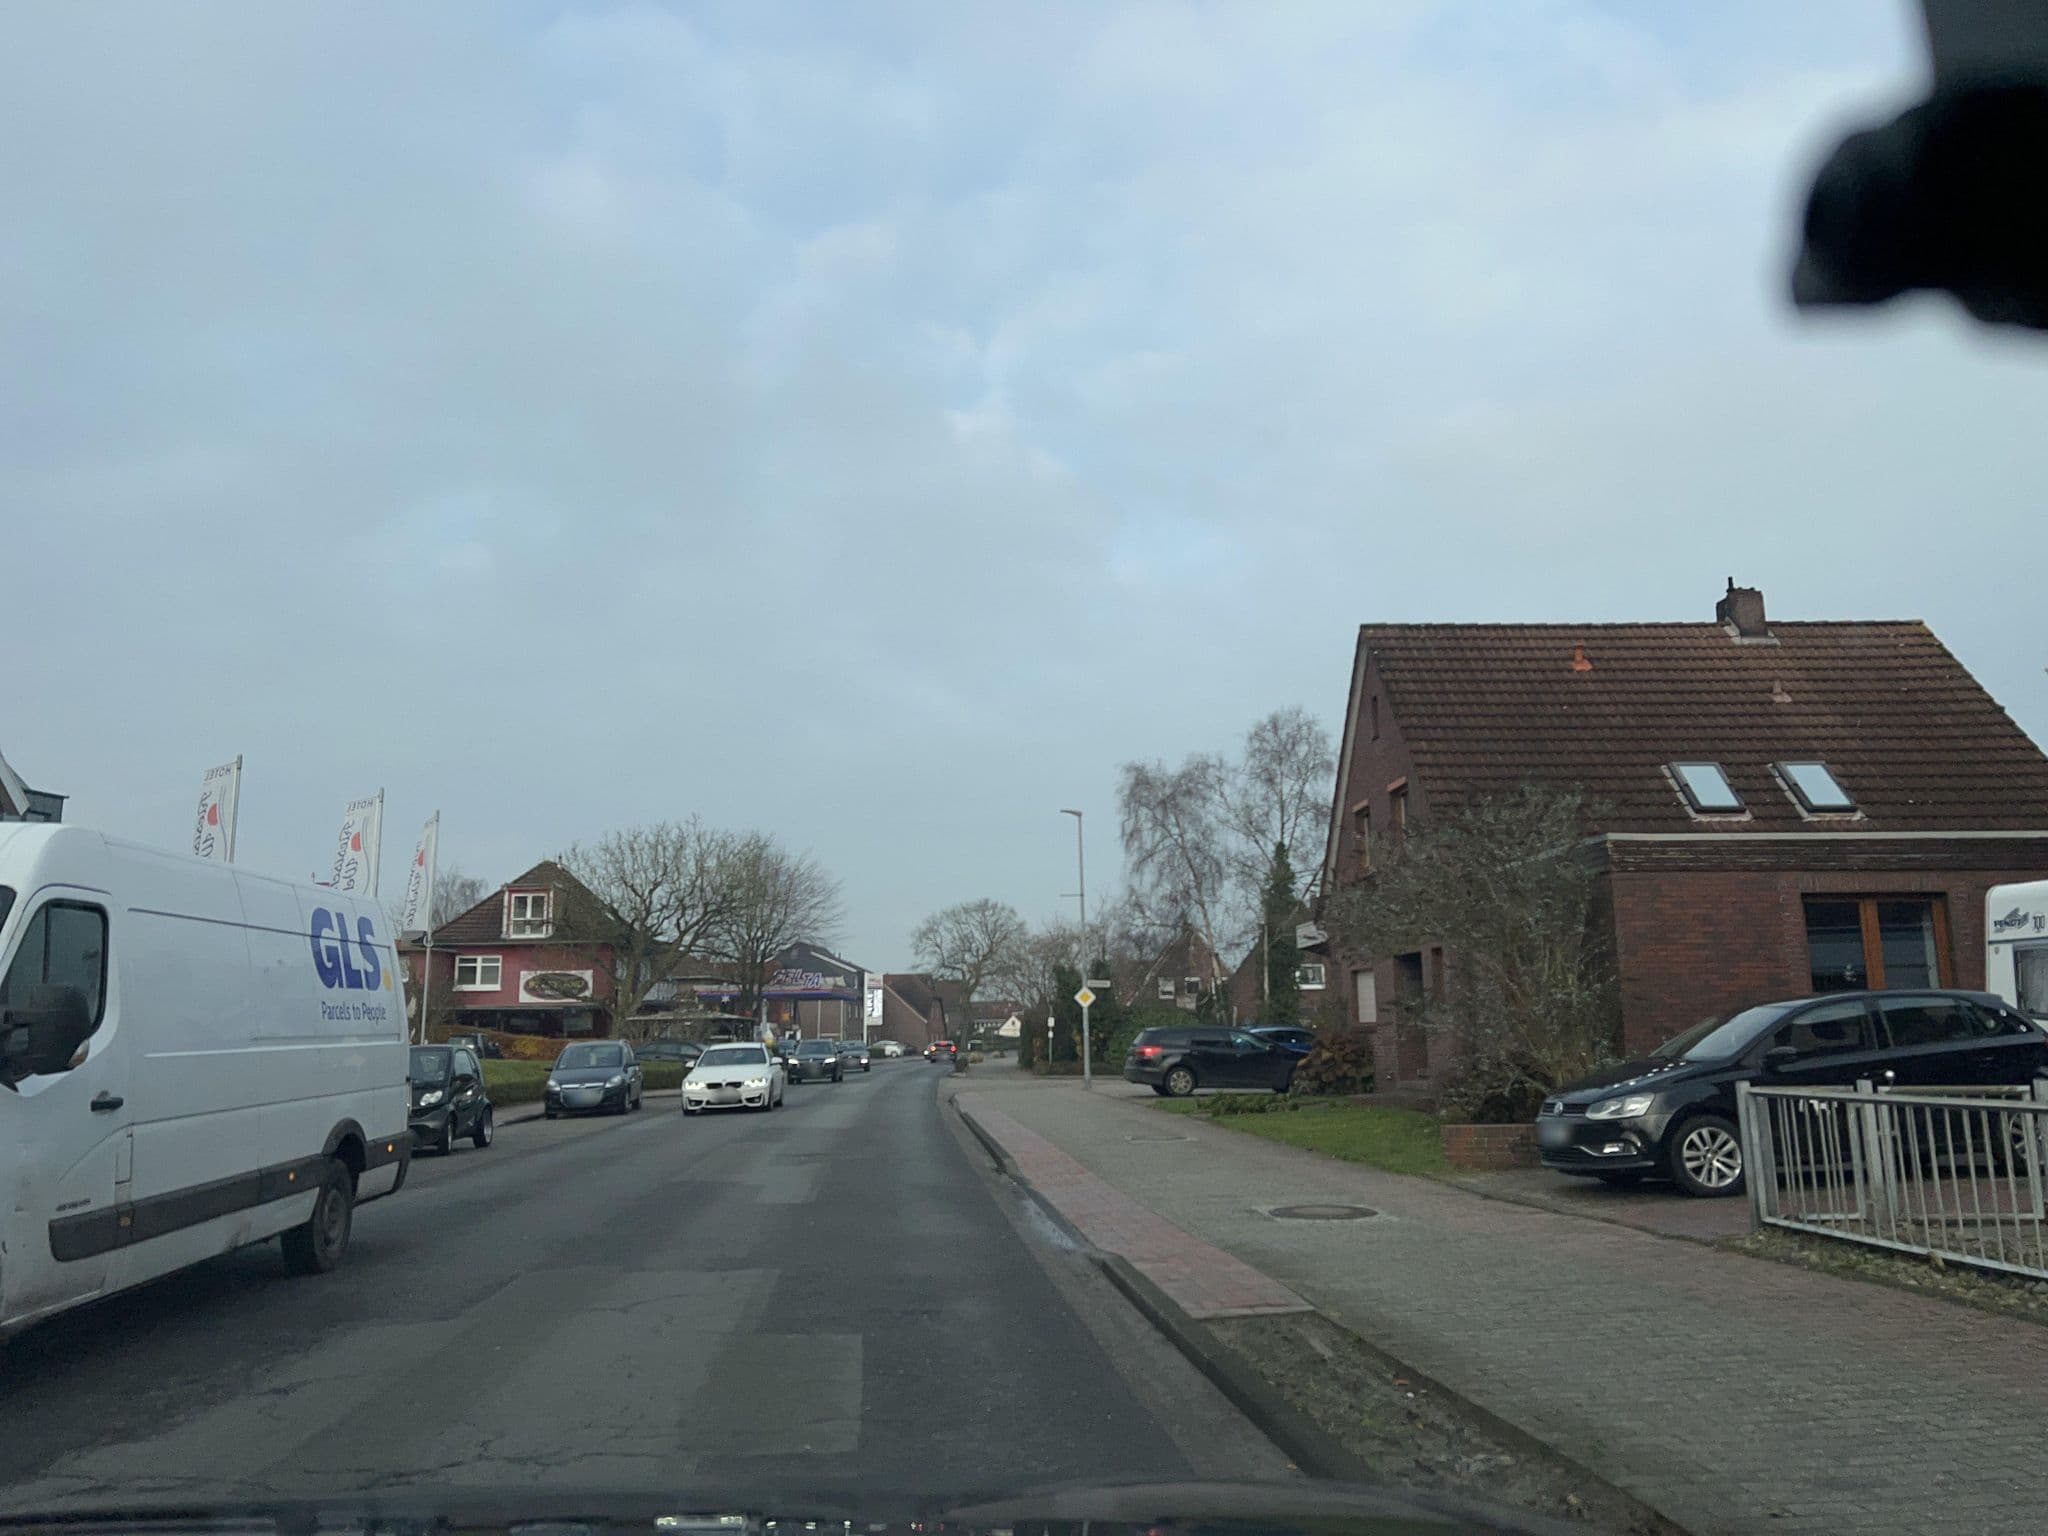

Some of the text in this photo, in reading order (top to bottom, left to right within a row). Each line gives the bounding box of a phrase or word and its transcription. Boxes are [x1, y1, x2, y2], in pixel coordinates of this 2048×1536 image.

[310, 906, 381, 991] GLS
[321, 1001, 387, 1024] Parcels to People
